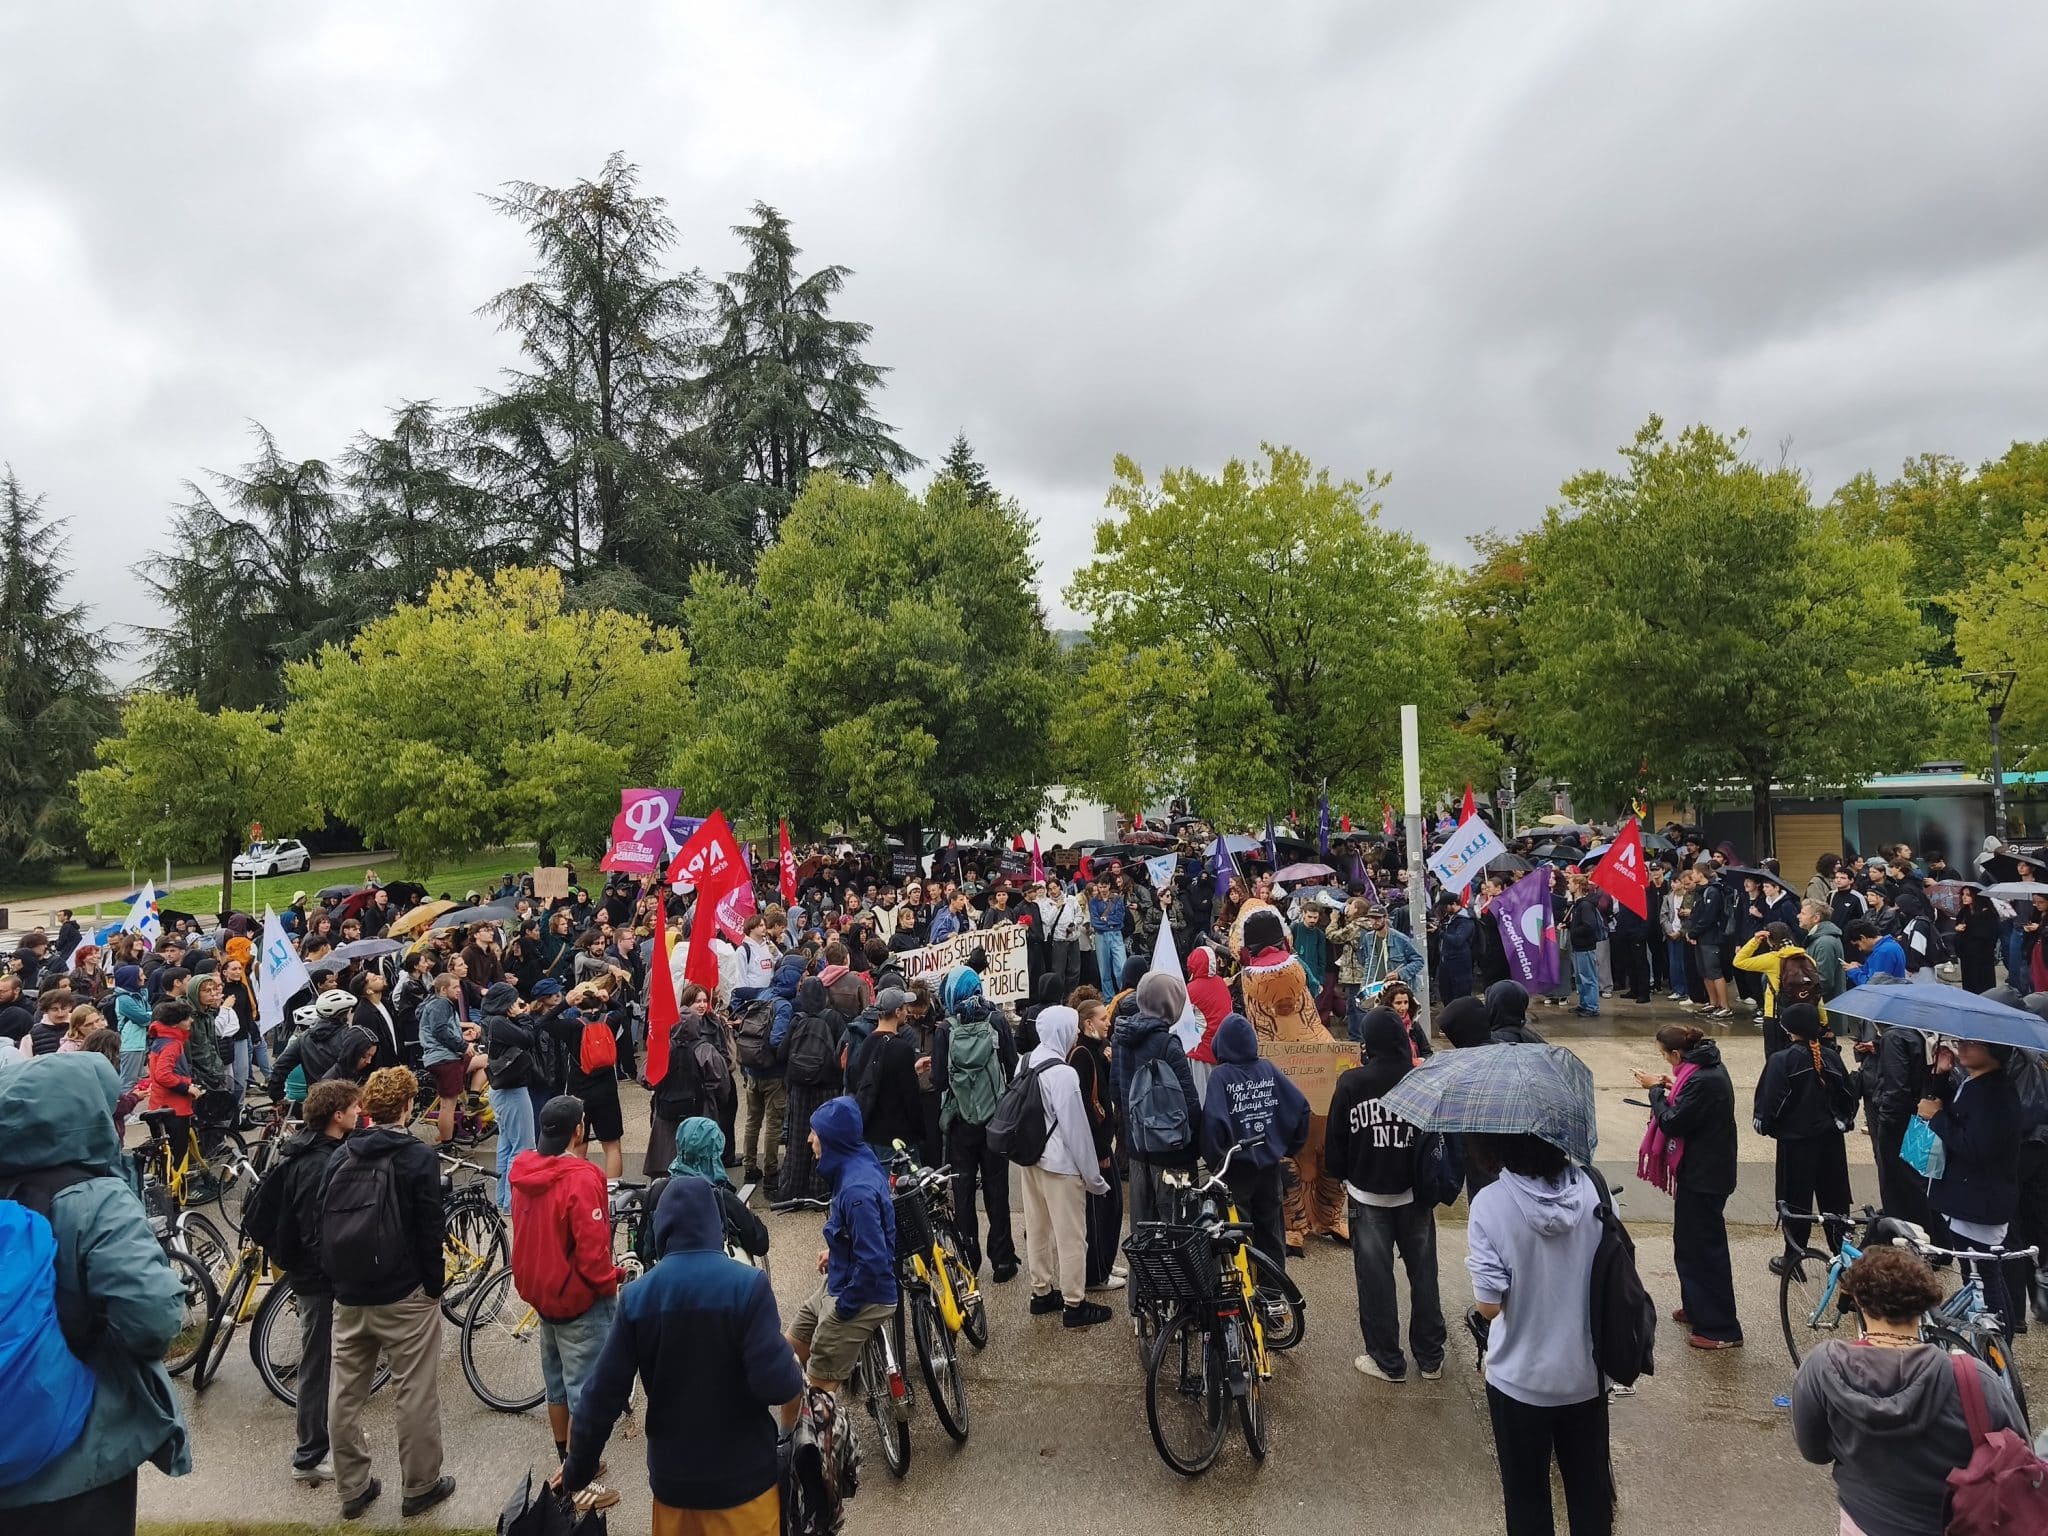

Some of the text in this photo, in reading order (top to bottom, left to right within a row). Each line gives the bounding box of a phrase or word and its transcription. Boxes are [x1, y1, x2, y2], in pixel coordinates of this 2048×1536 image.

[1502, 914, 1533, 980] Coordination
[989, 968, 1025, 997] PUBLIC
[1284, 1044, 1322, 1055] VEULENT
[1327, 1044, 1358, 1055] NOTRE
[1226, 1076, 1275, 1093] Not Rushed
[1233, 1087, 1272, 1102] Not Loud
[1230, 1101, 1262, 1114] Always
[1373, 1125, 1391, 1147] IN
